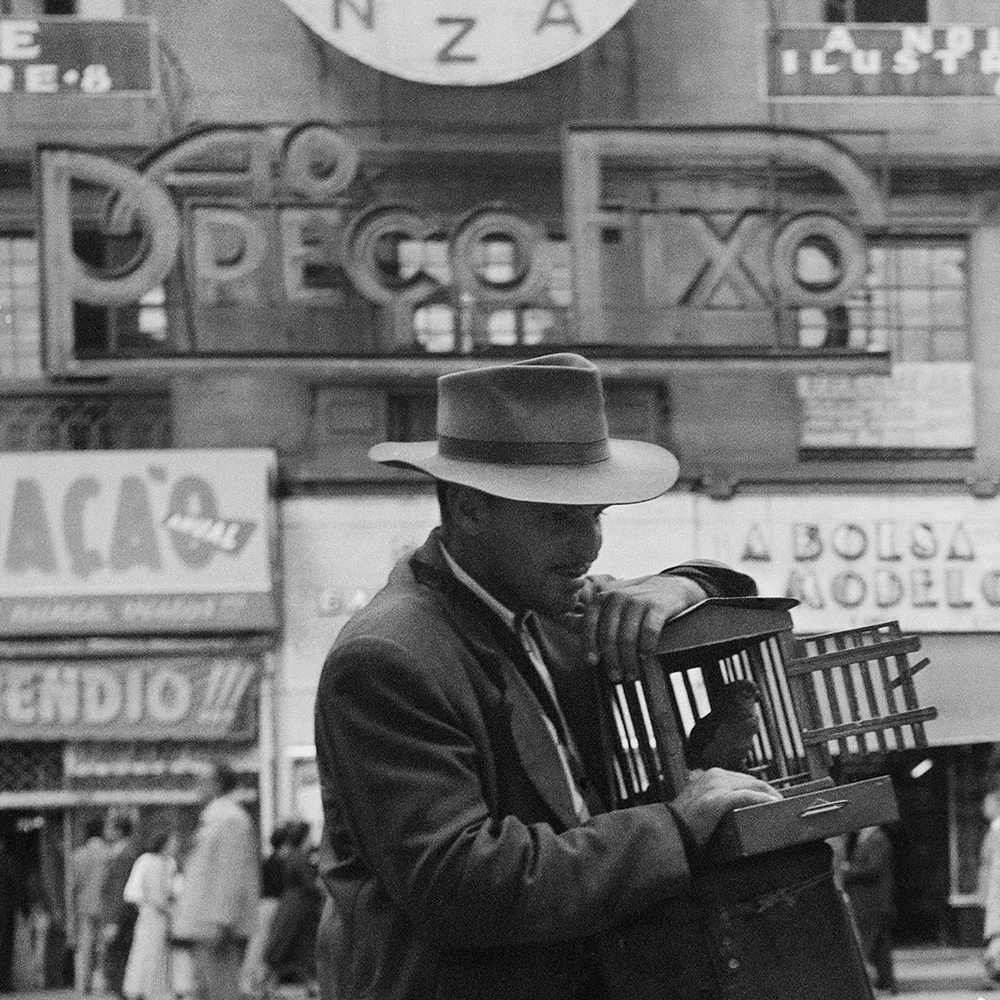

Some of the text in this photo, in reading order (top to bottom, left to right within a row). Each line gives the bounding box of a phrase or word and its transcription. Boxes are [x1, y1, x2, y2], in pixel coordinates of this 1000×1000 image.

[824, 26, 857, 52] A
[741, 520, 977, 562] A BOLSA
